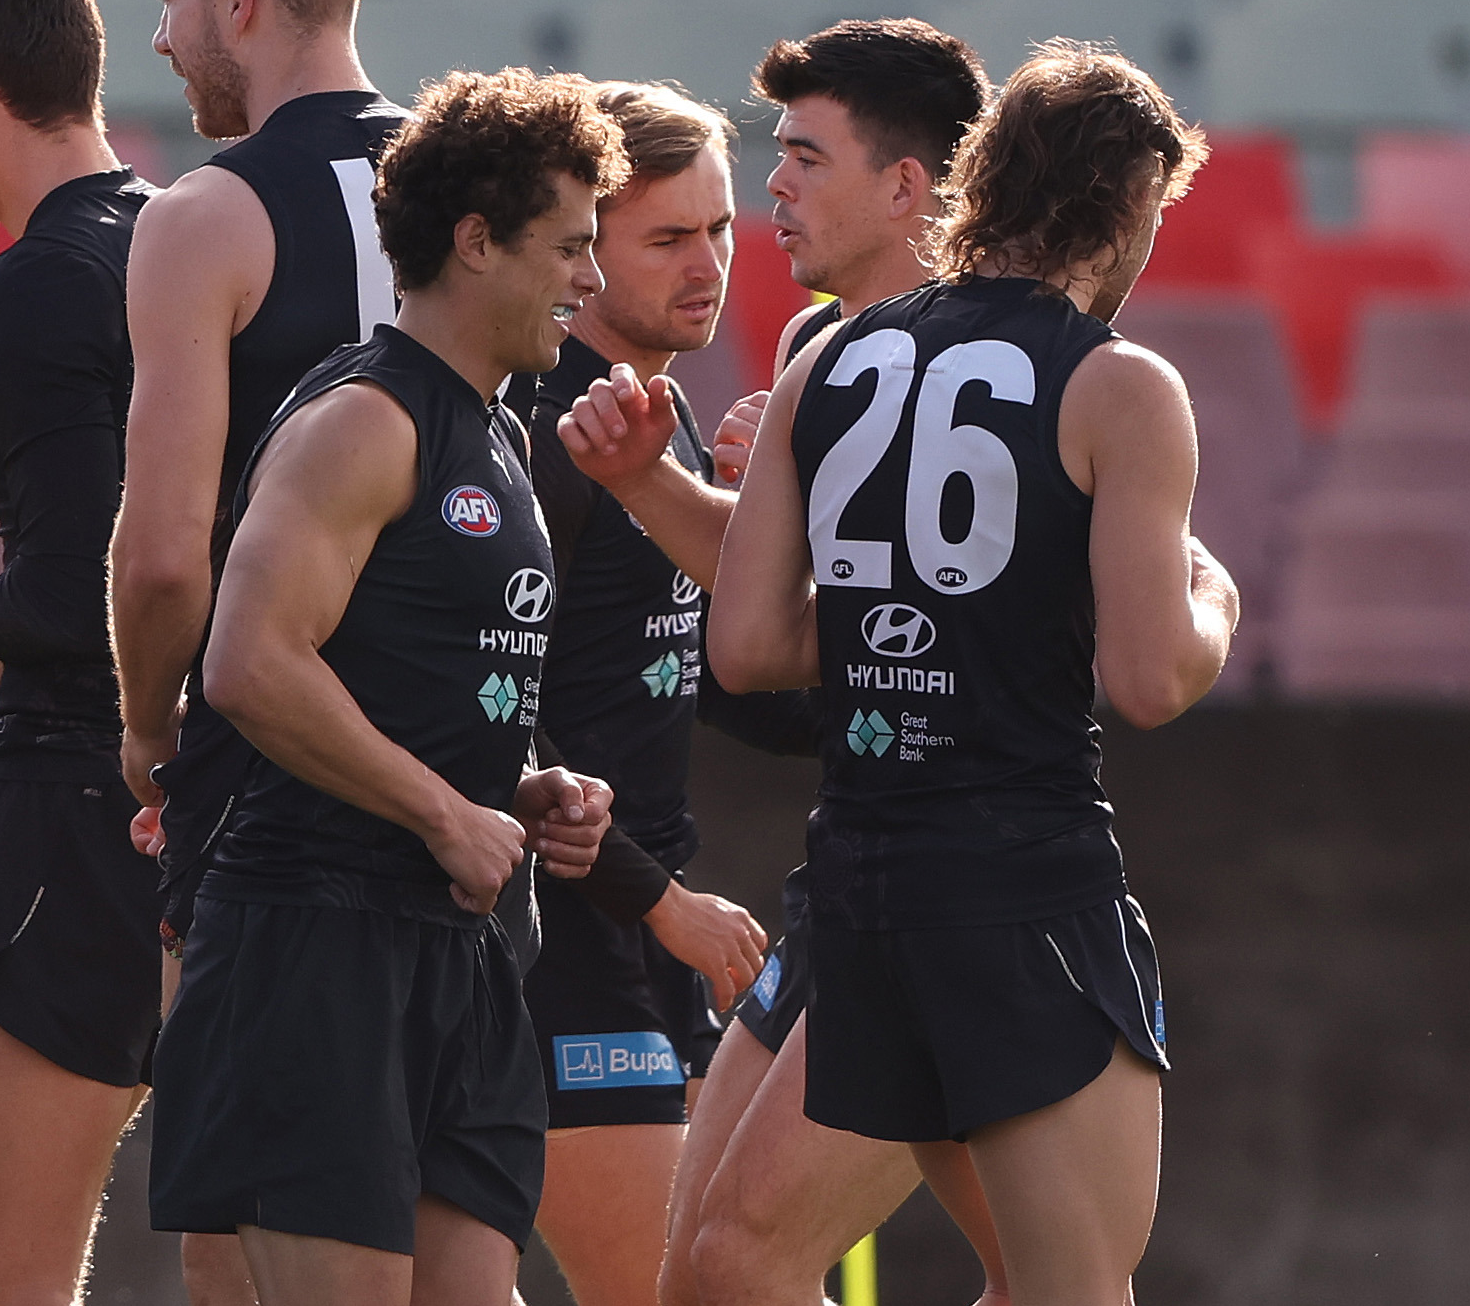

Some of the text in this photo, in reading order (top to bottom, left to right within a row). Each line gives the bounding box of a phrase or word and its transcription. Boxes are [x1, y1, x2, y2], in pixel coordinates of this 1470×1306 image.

[808, 328, 1036, 595] 26
[451, 497, 498, 525] AFL
[832, 562, 855, 577] AFL
[937, 570, 966, 584] AFL
[846, 663, 955, 695] HYUNDAI
[900, 711, 928, 730] Great
[900, 728, 955, 747] Southern
[899, 745, 926, 762] Bank
[609, 1048, 674, 1076] Bupa
